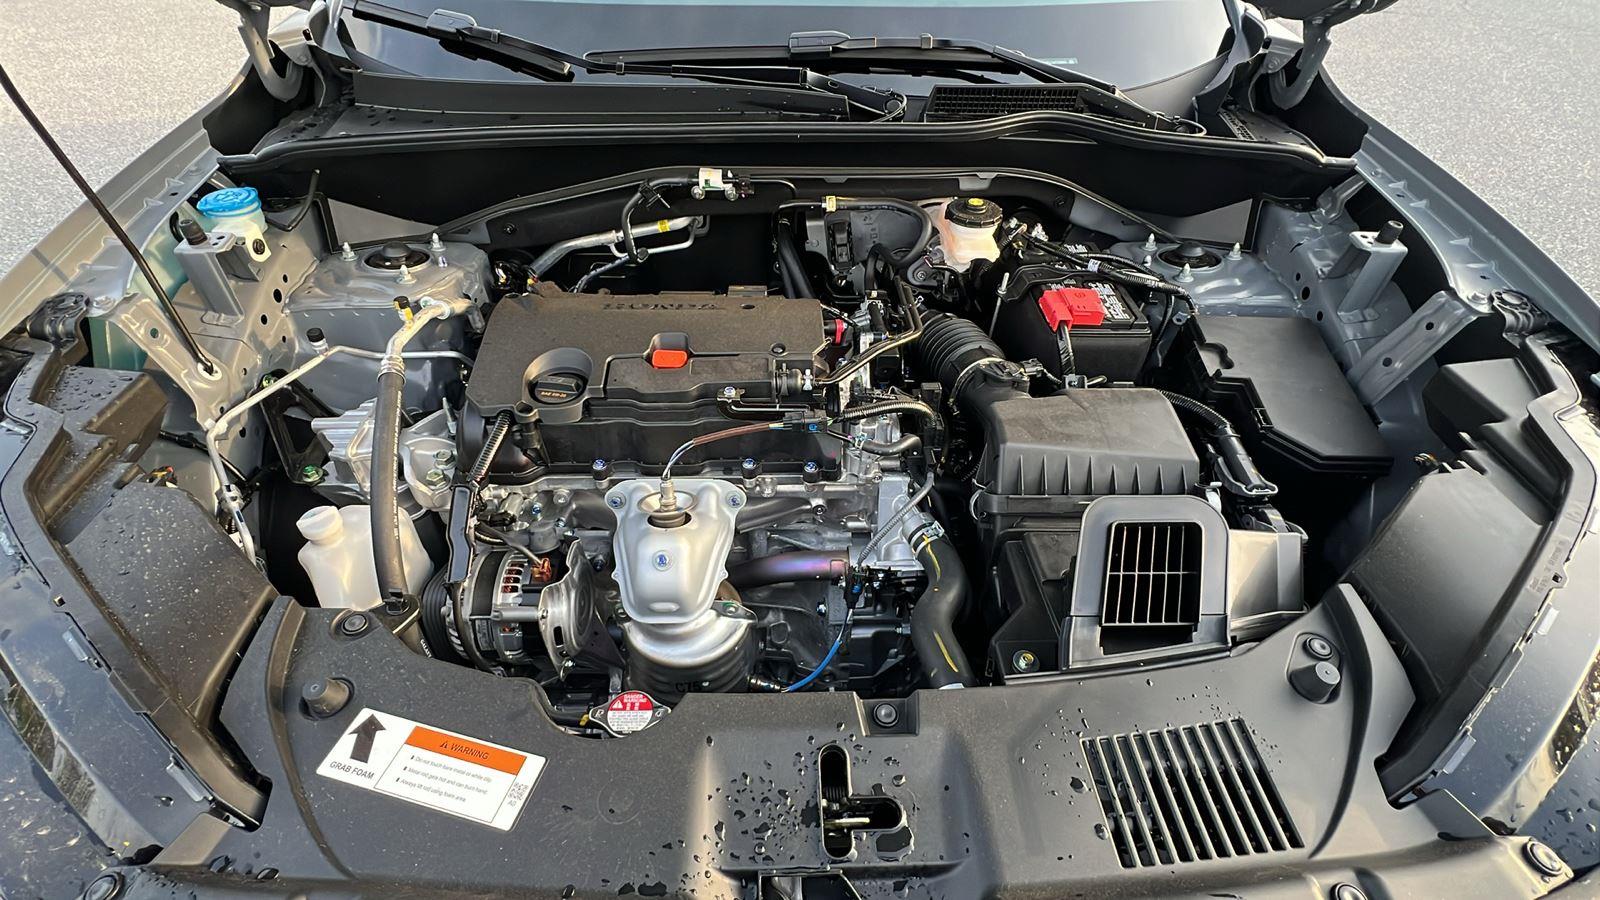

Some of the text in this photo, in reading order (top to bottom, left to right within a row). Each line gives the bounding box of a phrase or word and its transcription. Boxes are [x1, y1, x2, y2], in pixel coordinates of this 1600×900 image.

[450, 743, 490, 760] WARNING
[330, 761, 375, 780] GRAB FOAM
